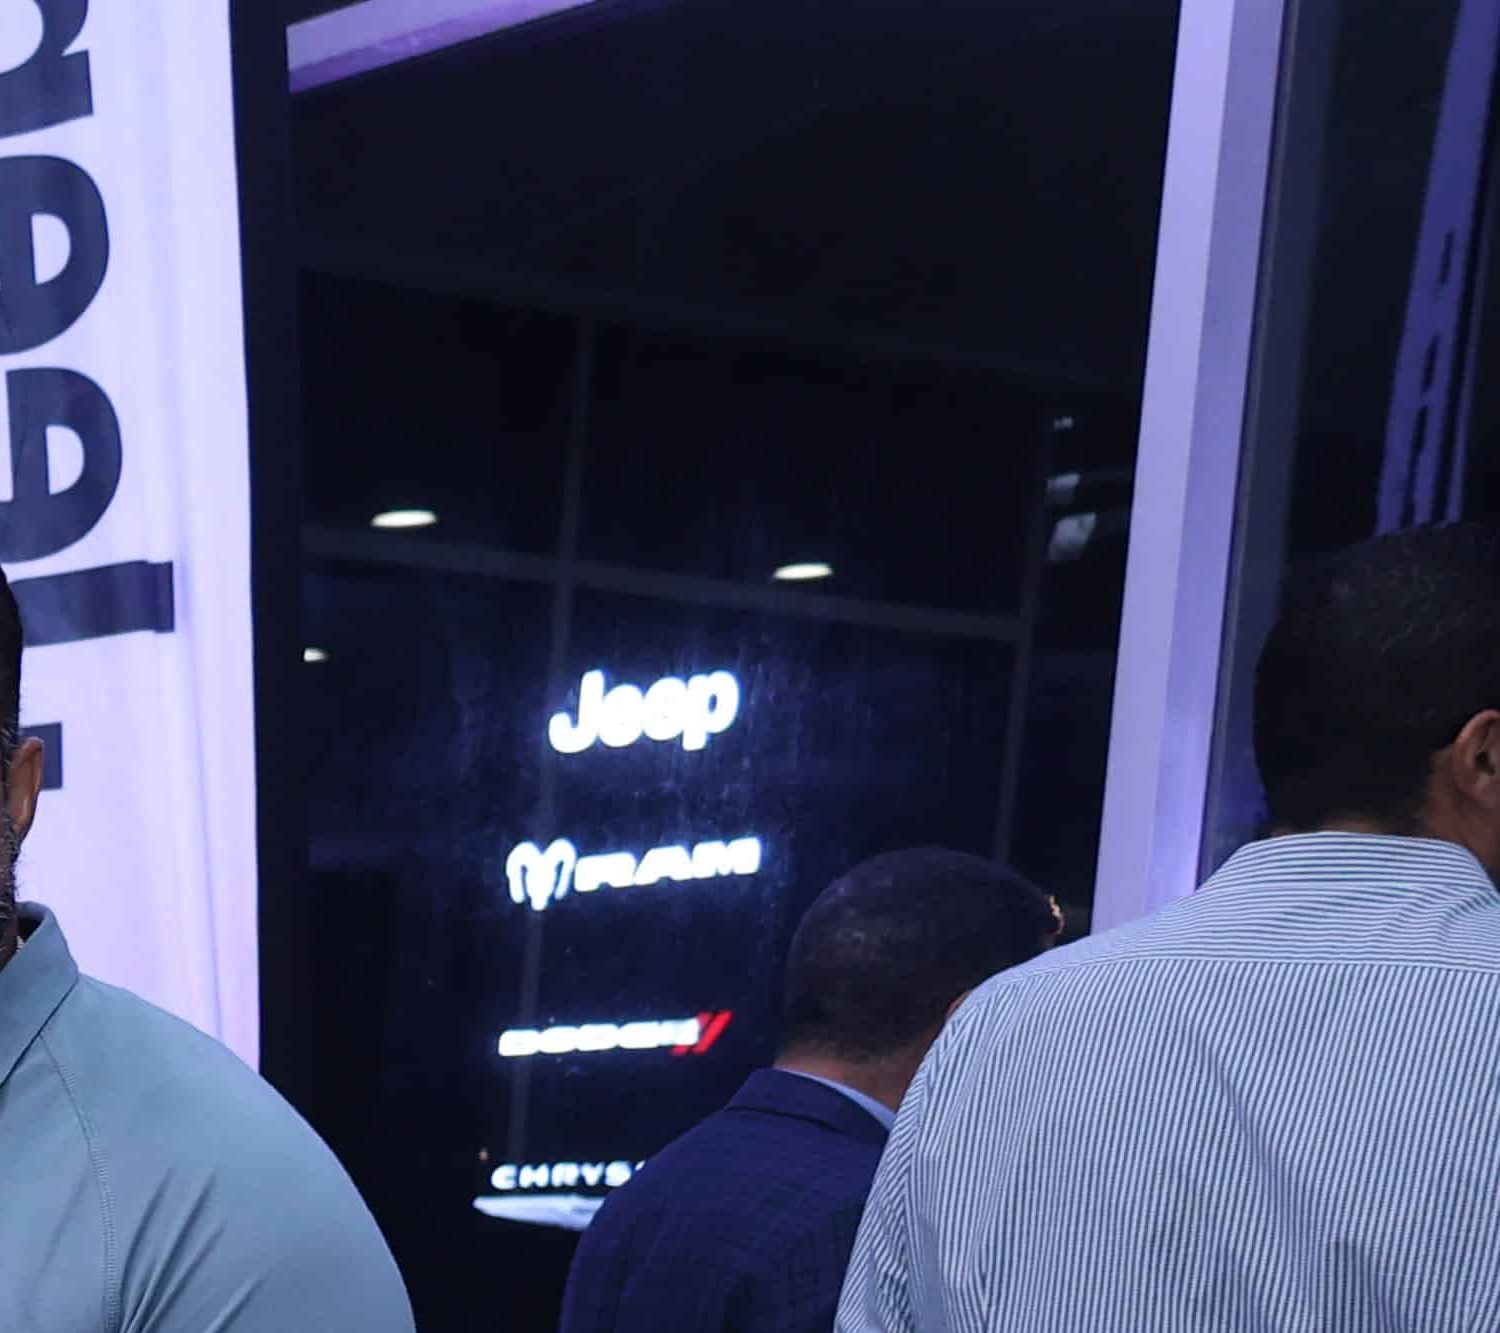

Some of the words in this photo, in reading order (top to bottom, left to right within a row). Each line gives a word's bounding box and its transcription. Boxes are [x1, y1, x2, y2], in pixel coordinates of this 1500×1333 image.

[548, 670, 740, 754] Jeep
[573, 837, 762, 893] RAM
[490, 1161, 645, 1190] CHRYS
